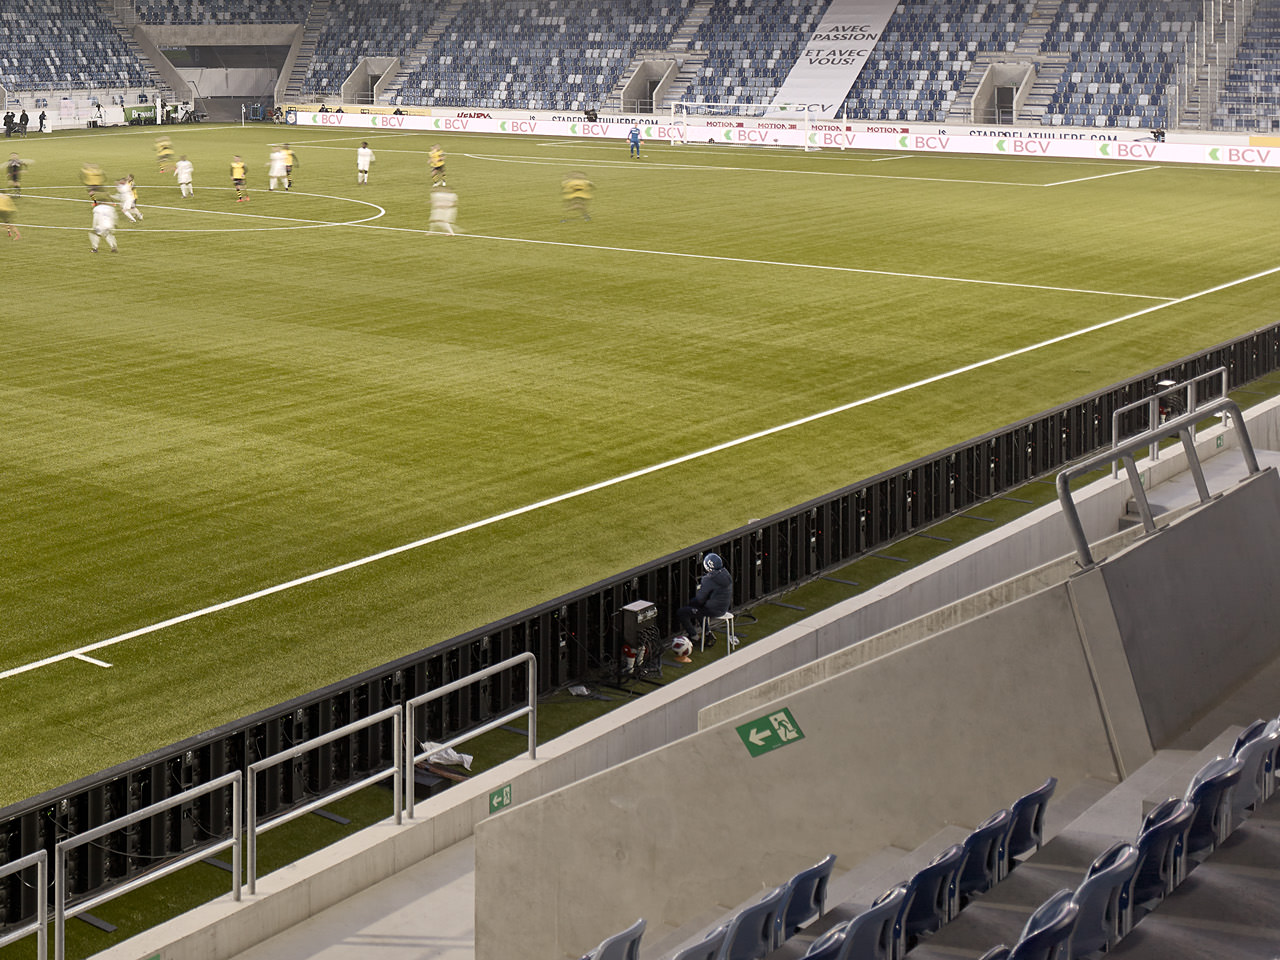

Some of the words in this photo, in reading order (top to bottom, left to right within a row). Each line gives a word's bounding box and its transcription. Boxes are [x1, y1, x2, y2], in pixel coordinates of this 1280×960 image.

[829, 25, 871, 33] AVEC
[812, 33, 878, 41] PASSION
[805, 49, 826, 57] ET
[827, 49, 869, 57] AVEC
[808, 58, 857, 66] VOUS!
[321, 114, 344, 125] BCV
[381, 116, 405, 127] BCV
[444, 119, 469, 130] BCV
[511, 121, 537, 133] BCV
[582, 124, 610, 136] BCV
[738, 129, 769, 143] BCV
[823, 133, 856, 146] BCV
[915, 136, 950, 150] BCV
[1013, 139, 1051, 153] BCV
[1118, 144, 1157, 158] BCV
[1228, 148, 1271, 163] BCV
